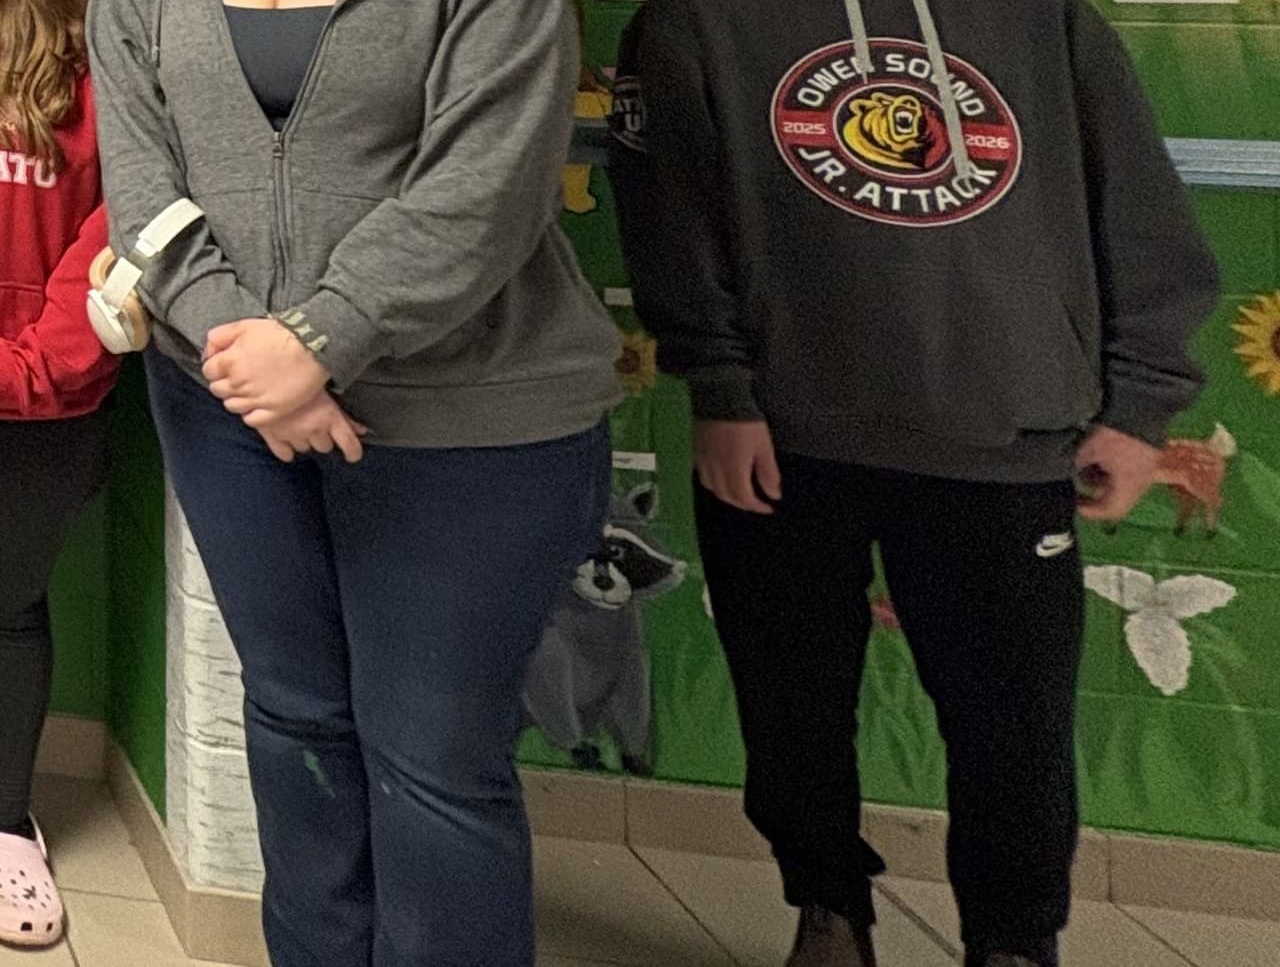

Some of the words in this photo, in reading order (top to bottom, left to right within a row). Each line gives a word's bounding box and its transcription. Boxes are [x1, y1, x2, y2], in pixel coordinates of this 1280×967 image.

[885, 52, 986, 117] SOND
[783, 121, 826, 135] 2025
[965, 134, 1010, 150] 2026
